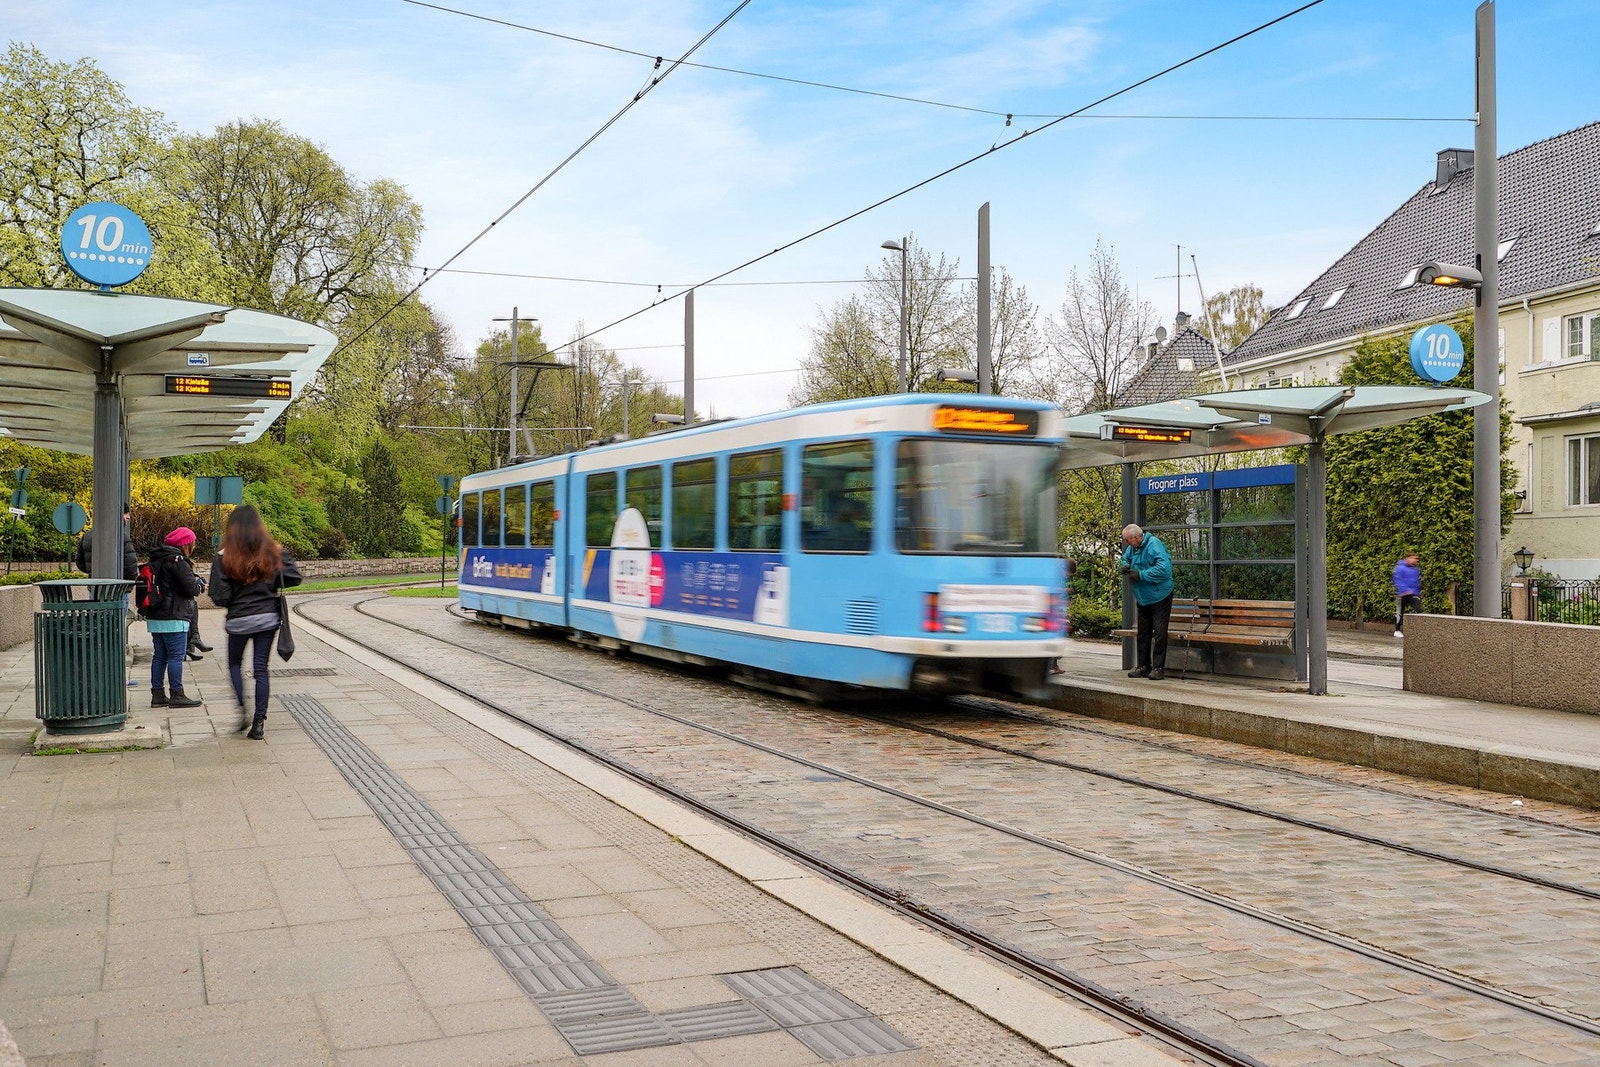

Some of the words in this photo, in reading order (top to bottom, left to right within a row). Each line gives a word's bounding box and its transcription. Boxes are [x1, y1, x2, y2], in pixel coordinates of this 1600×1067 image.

[77, 214, 124, 252] 10
[121, 242, 148, 254] min
[1426, 333, 1450, 359] 10
[1449, 351, 1462, 360] min
[175, 377, 184, 385] 12
[1148, 478, 1177, 493] Frogner
[1179, 475, 1198, 489] plass
